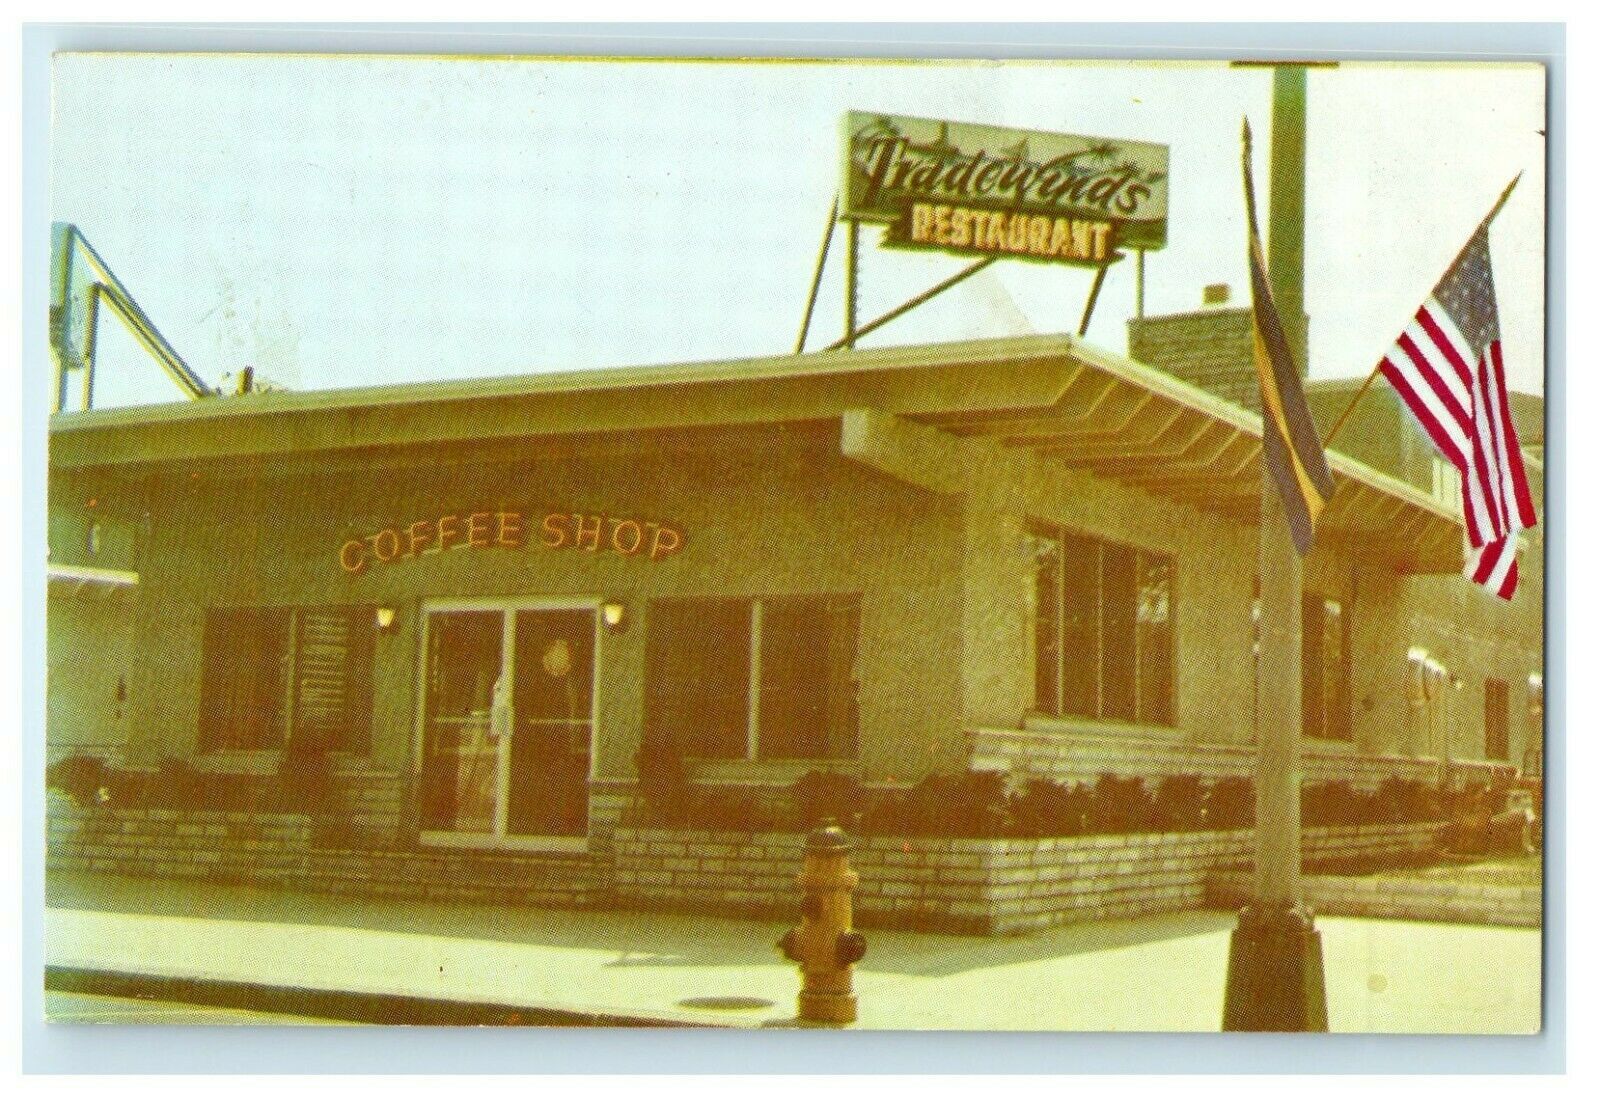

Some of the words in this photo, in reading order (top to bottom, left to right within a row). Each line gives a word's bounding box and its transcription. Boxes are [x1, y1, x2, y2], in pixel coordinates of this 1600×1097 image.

[911, 202, 1113, 262] RESTAURANT
[340, 512, 522, 571] COFFEE
[543, 513, 682, 562] SHOP
